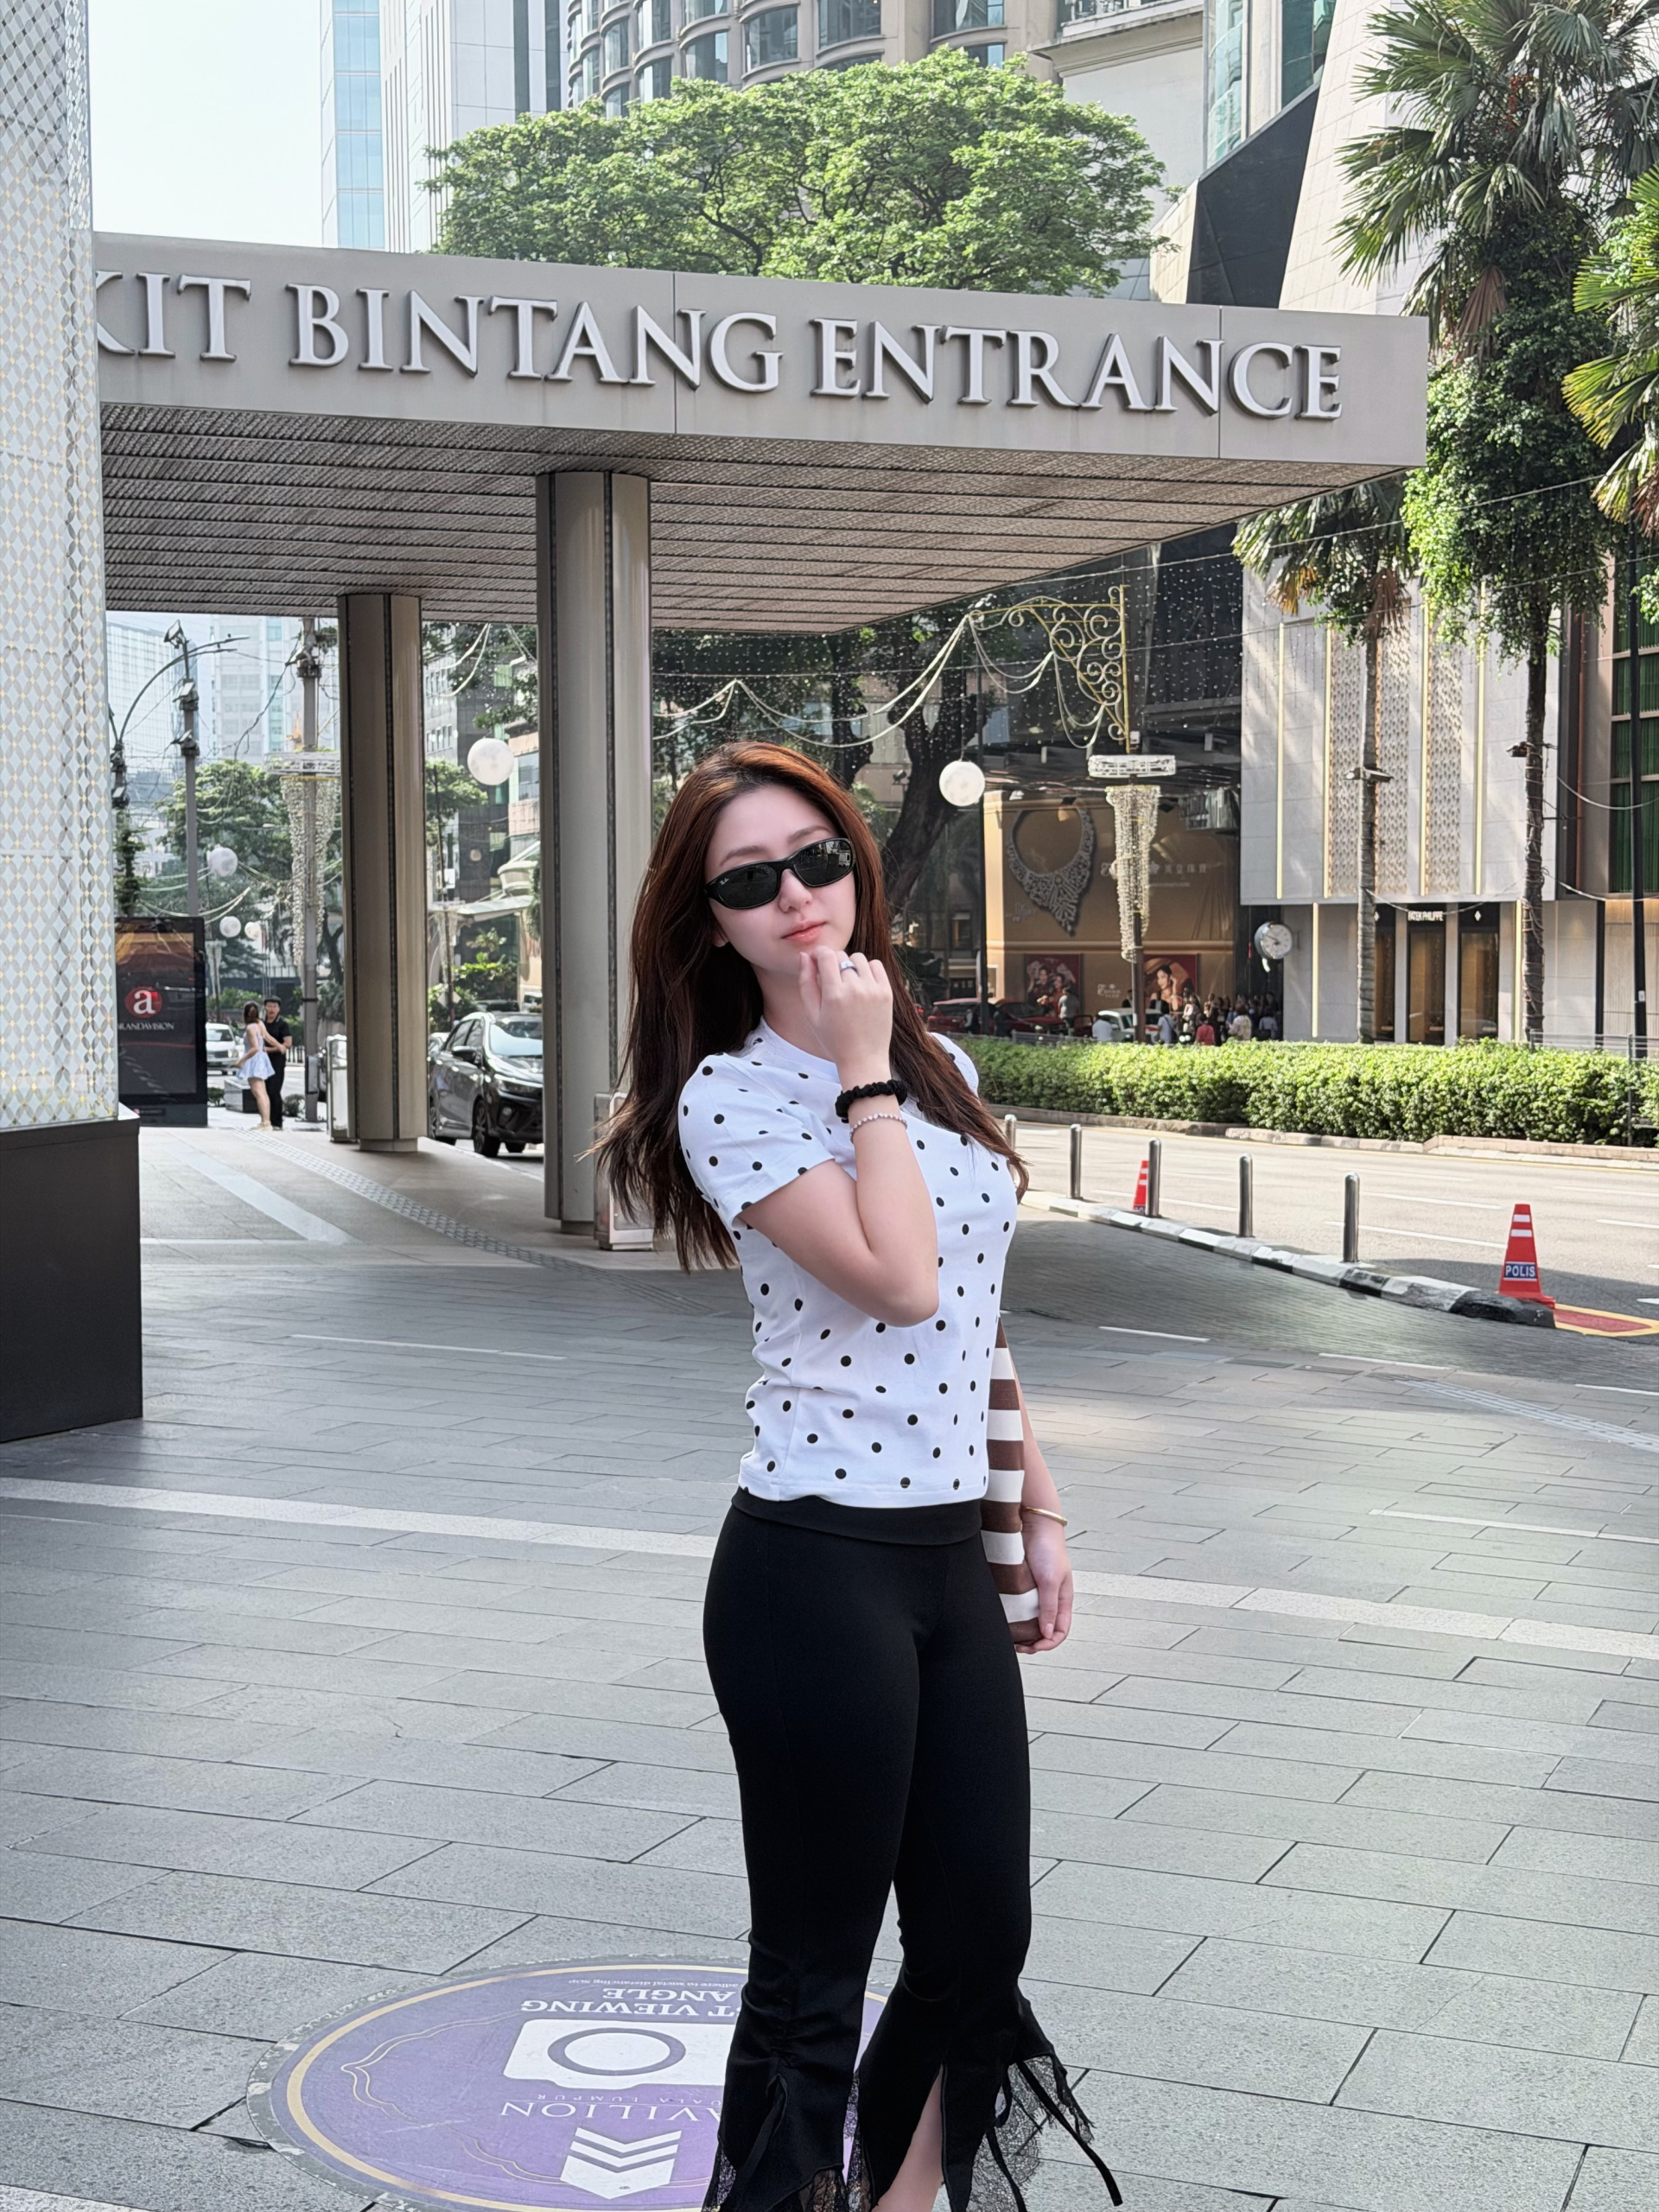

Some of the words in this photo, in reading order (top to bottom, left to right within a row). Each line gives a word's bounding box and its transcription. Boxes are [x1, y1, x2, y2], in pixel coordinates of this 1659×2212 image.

[285, 282, 784, 393] BINTANG
[808, 317, 1343, 421] ENTRANCE
[1505, 1265, 1536, 1277] POLIS
[602, 1987, 736, 2002] ANGLE
[520, 1999, 699, 2017] VIEWING
